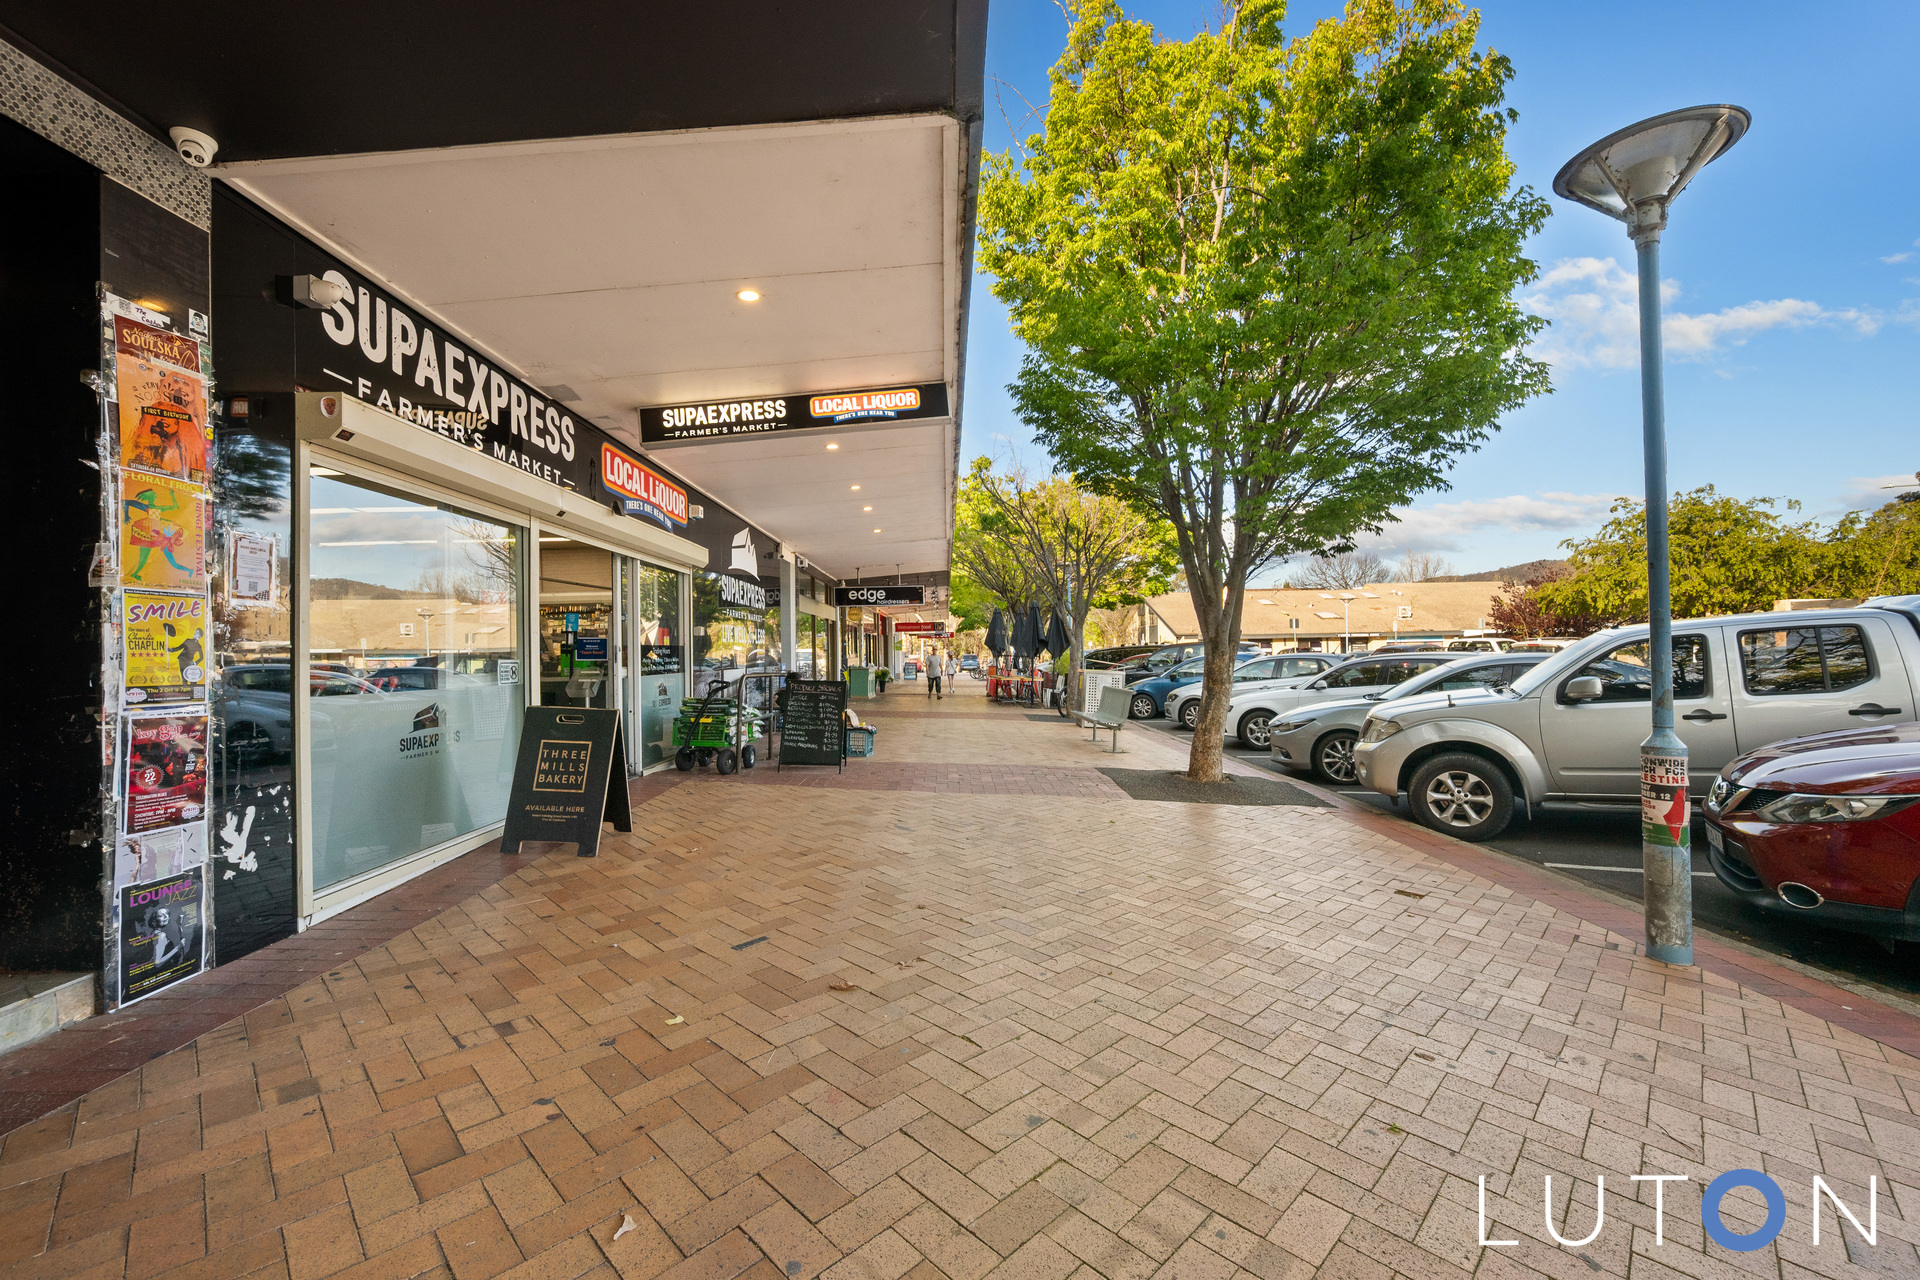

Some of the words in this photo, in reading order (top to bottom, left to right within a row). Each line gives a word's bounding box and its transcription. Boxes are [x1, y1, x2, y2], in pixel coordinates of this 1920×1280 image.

[122, 328, 180, 359] SOULSKA
[321, 269, 575, 462] SUPAEXPRESS
[662, 399, 787, 428] SUPAEXPRESS
[814, 396, 861, 414] LOCAL
[358, 376, 484, 450] FARMER'S
[494, 440, 562, 484] MARKET
[675, 426, 728, 438] FARMER'S
[733, 422, 777, 433] MARKET
[124, 471, 168, 486] FLORAL
[170, 480, 201, 493] FROCK
[606, 451, 648, 499] LOCAL
[626, 500, 643, 510] THERE'S
[644, 503, 653, 514] ONE
[654, 507, 664, 521] NEAR
[722, 574, 766, 610] SUPAEXPRESS
[848, 588, 886, 602] edge
[127, 600, 203, 624] SMILE
[726, 608, 747, 620] FARMER'S
[748, 613, 762, 622] MARKET
[128, 632, 154, 641] Charlie
[722, 624, 734, 643] LIVE
[734, 626, 746, 643] WELL
[755, 628, 766, 644] LESS
[128, 640, 165, 650] CHAPLIN
[400, 730, 460, 752] SUPAEXPS
[543, 749, 587, 760] THREE
[540, 762, 585, 772] MILLS
[1665, 767, 1685, 775] FOR
[144, 773, 156, 783] 22
[538, 774, 583, 784] BAKERY
[1641, 790, 1656, 798] BER
[130, 880, 191, 907] LOUNGE
[165, 885, 197, 906] JAZZ
